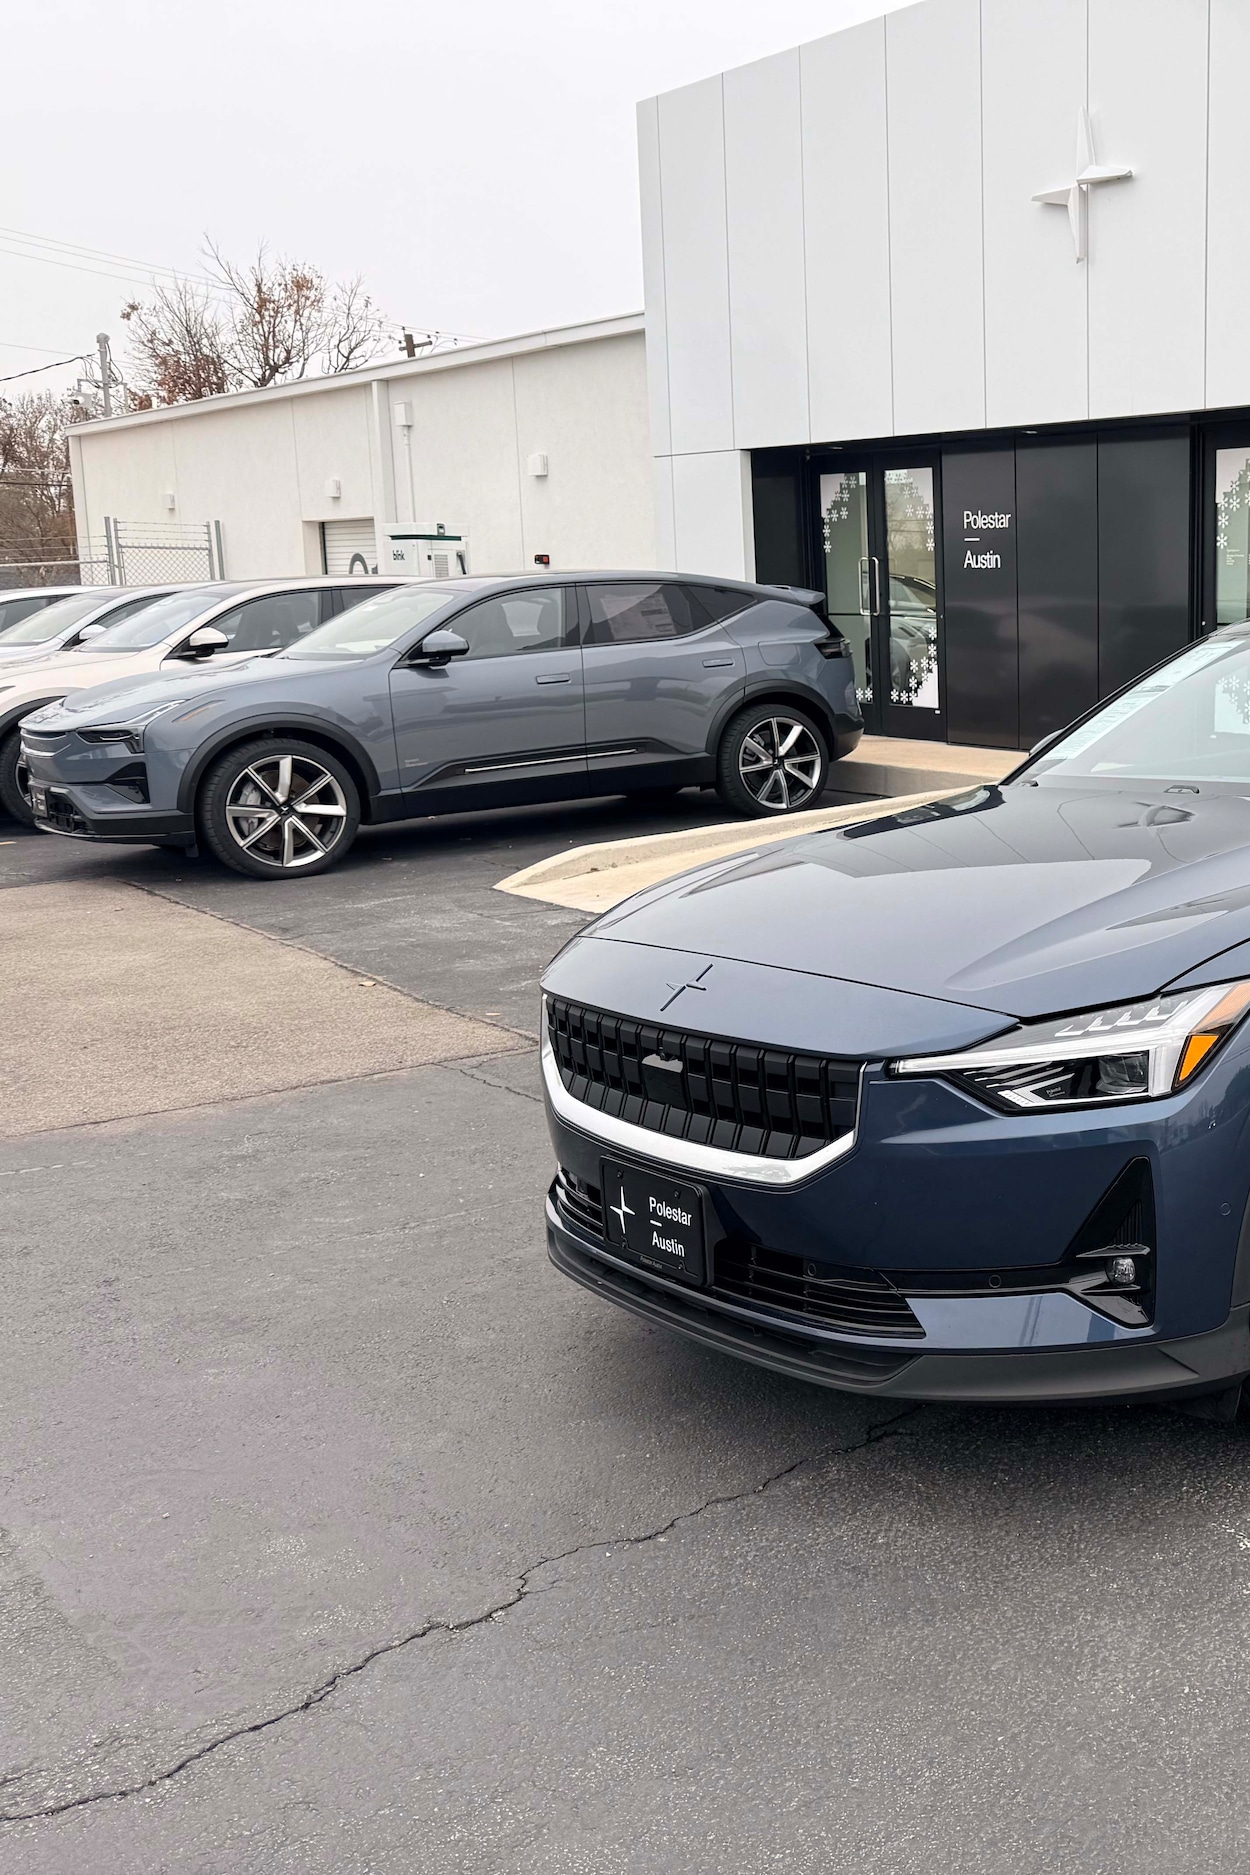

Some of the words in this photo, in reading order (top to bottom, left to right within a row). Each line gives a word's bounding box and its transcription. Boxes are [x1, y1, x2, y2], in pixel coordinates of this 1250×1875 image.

[963, 510, 1011, 529] Polestar
[963, 550, 1001, 568] Austin
[649, 1196, 692, 1226] Polestar
[652, 1231, 685, 1257] Austin
